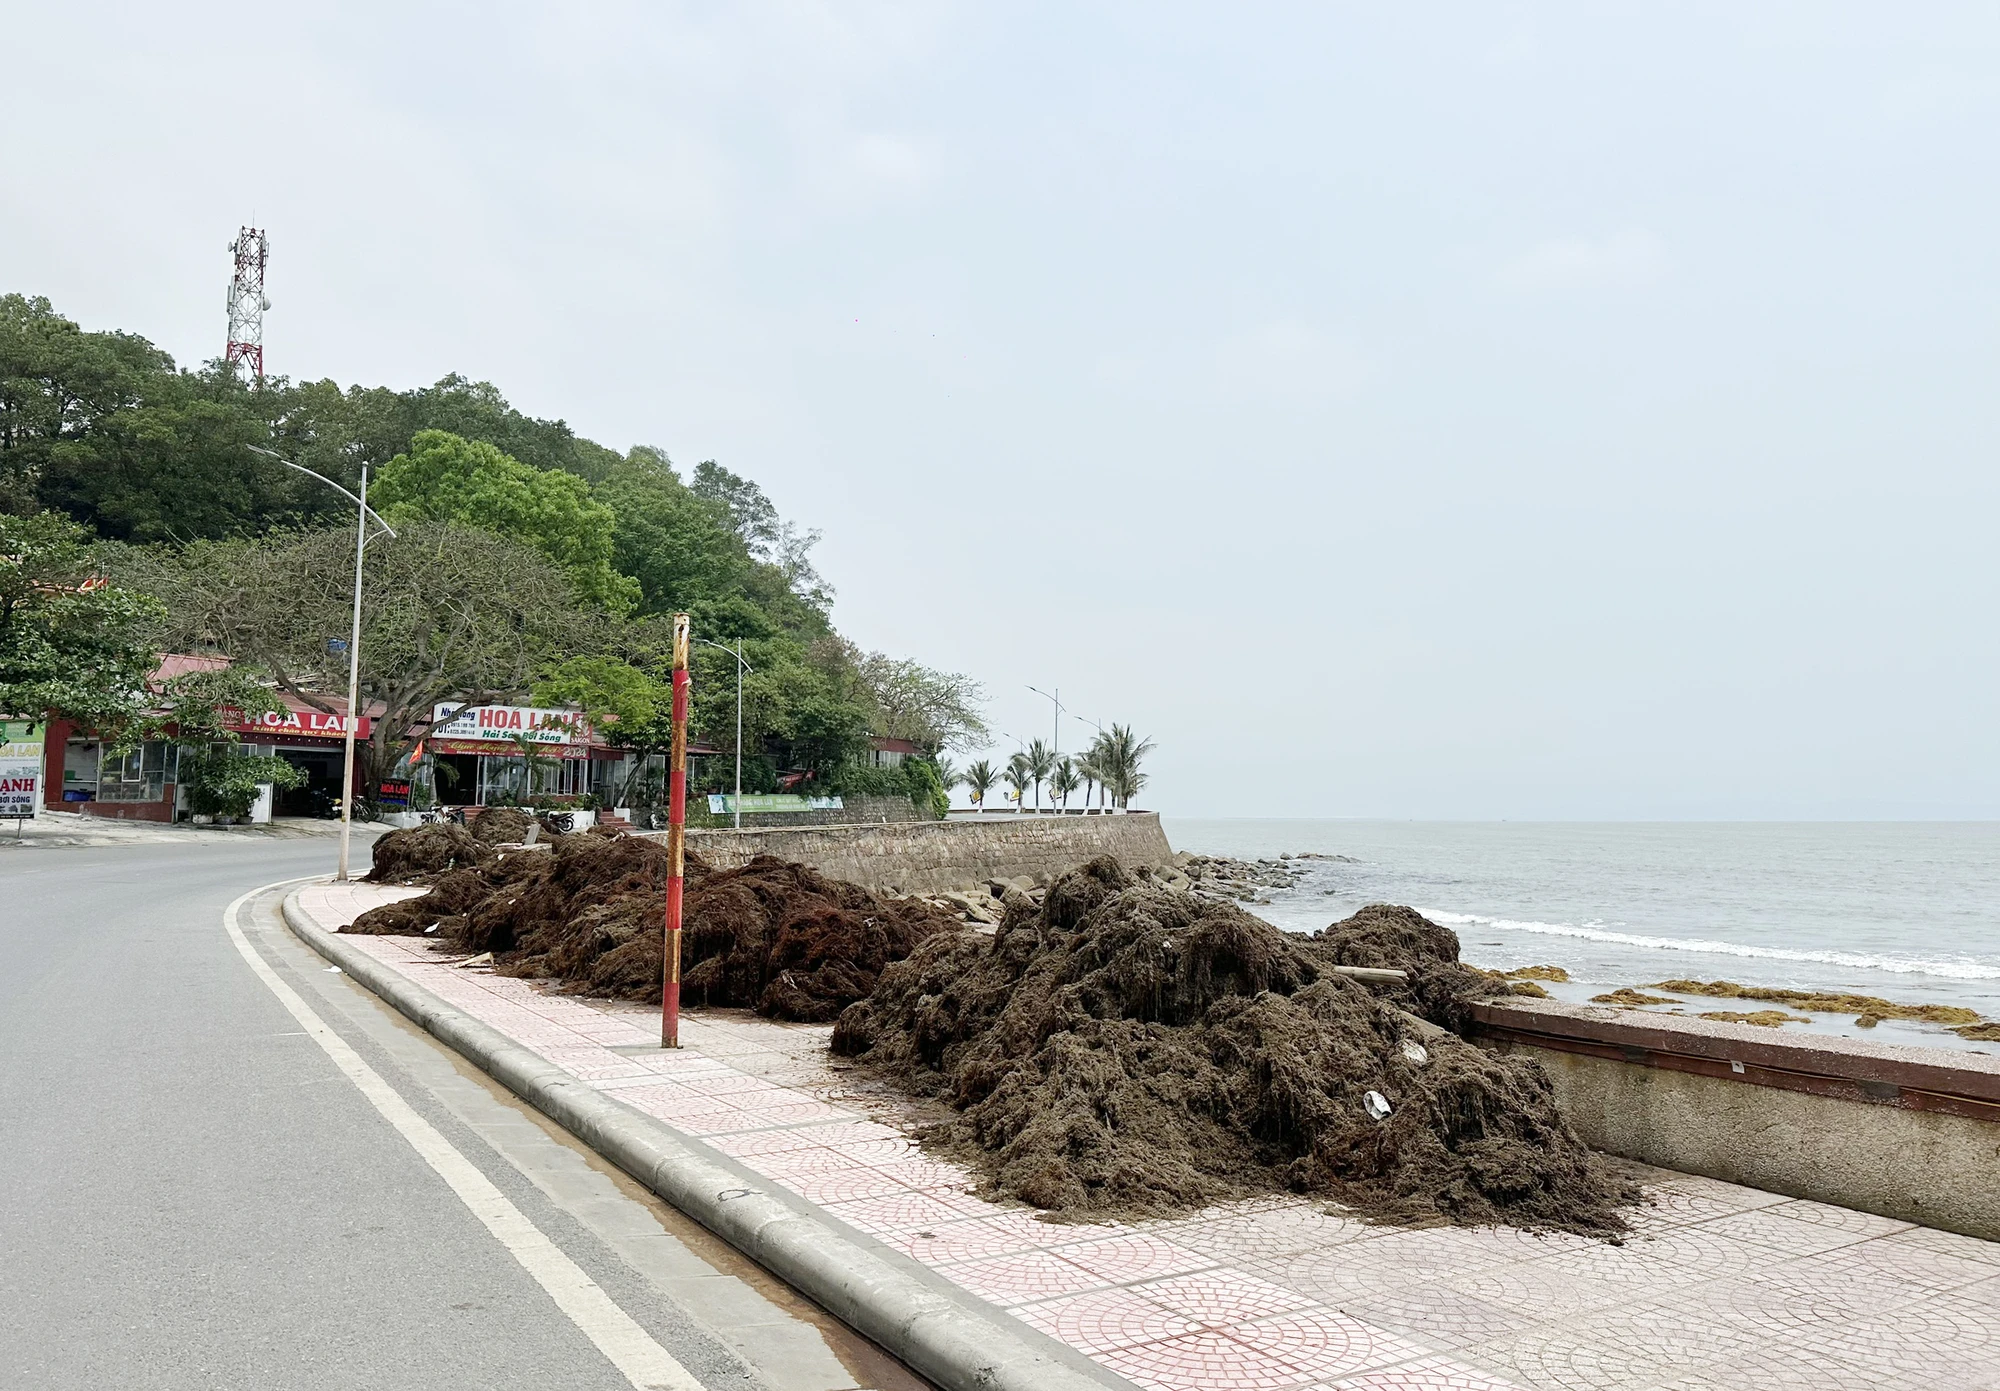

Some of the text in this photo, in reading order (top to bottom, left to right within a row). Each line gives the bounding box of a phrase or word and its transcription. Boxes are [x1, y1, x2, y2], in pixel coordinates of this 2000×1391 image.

[310, 714, 358, 732] LAN
[479, 709, 521, 729] HOA
[17, 745, 40, 757] LAN
